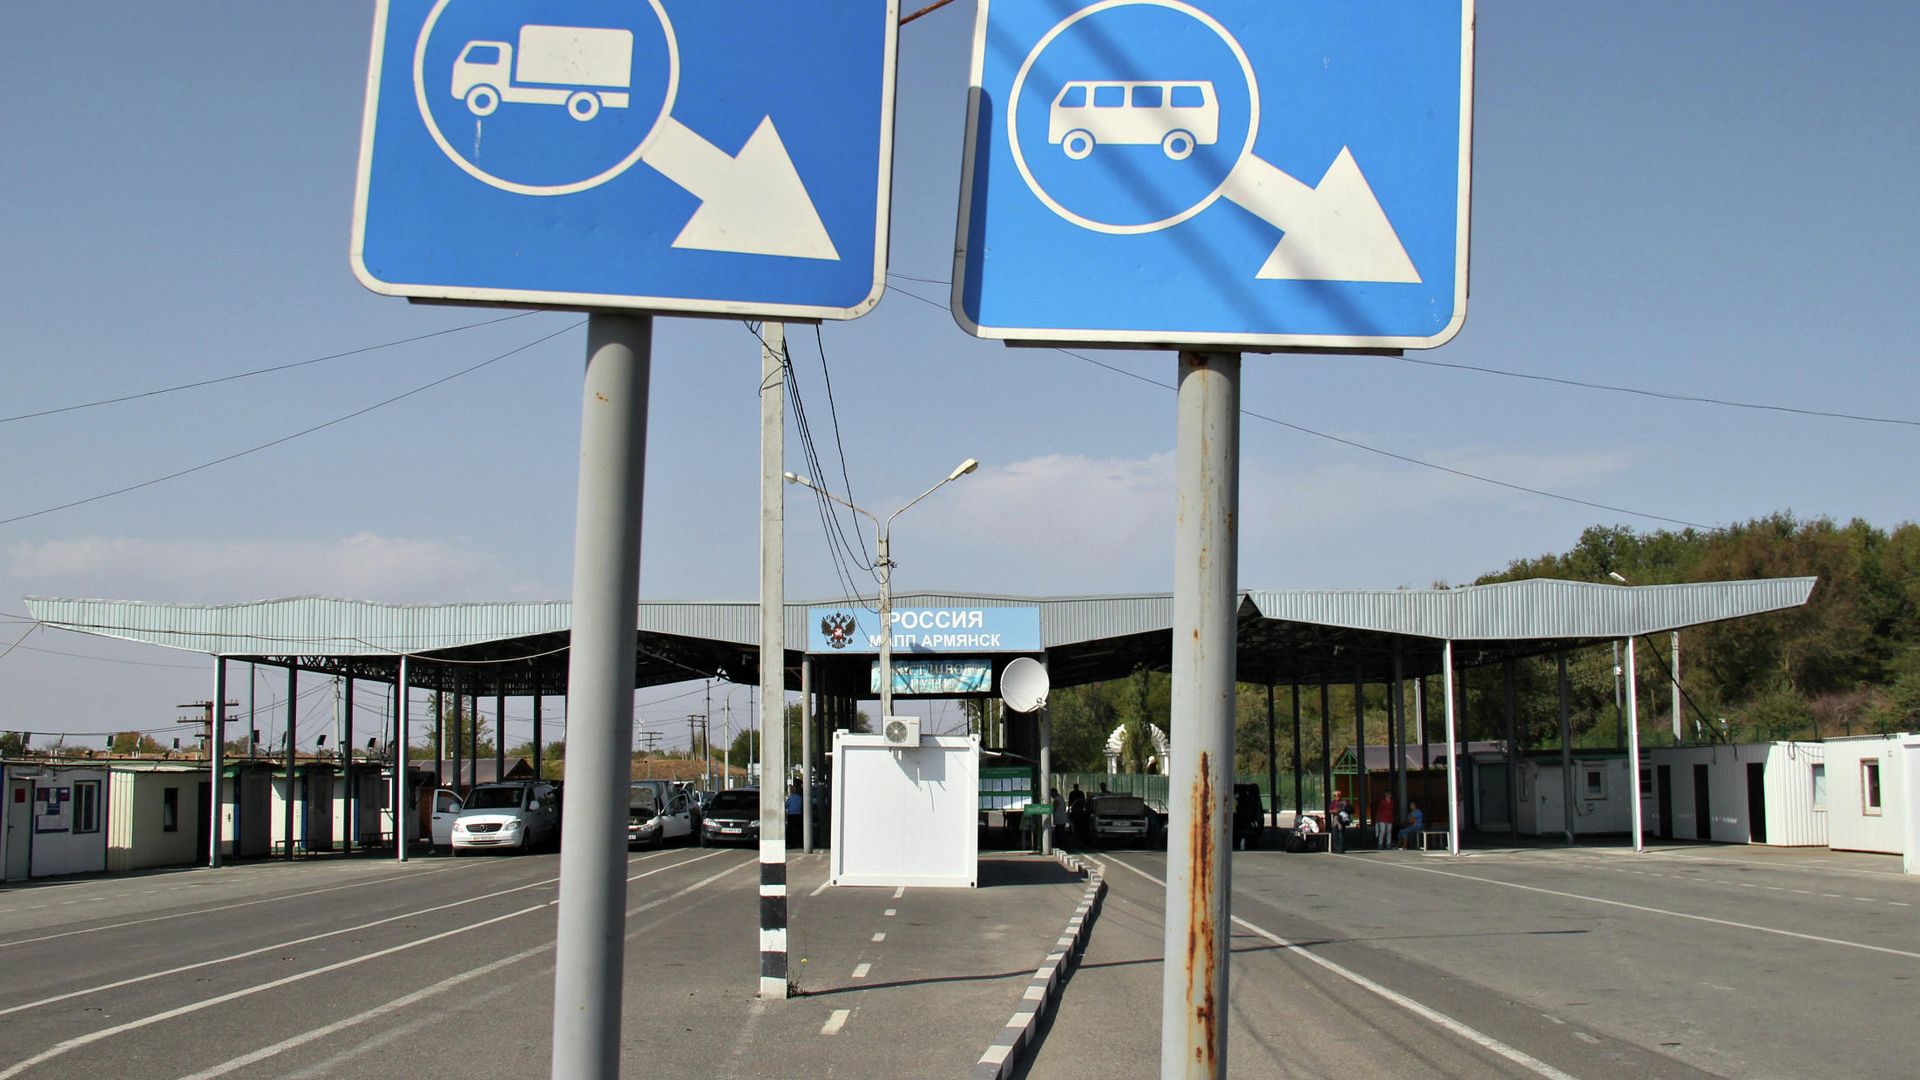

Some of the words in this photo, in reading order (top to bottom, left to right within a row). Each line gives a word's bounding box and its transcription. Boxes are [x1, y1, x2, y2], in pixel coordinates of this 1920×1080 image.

[889, 610, 983, 629] РОССИЯ
[869, 634, 916, 647] МПП
[921, 633, 1001, 647] АРМЯНСК
